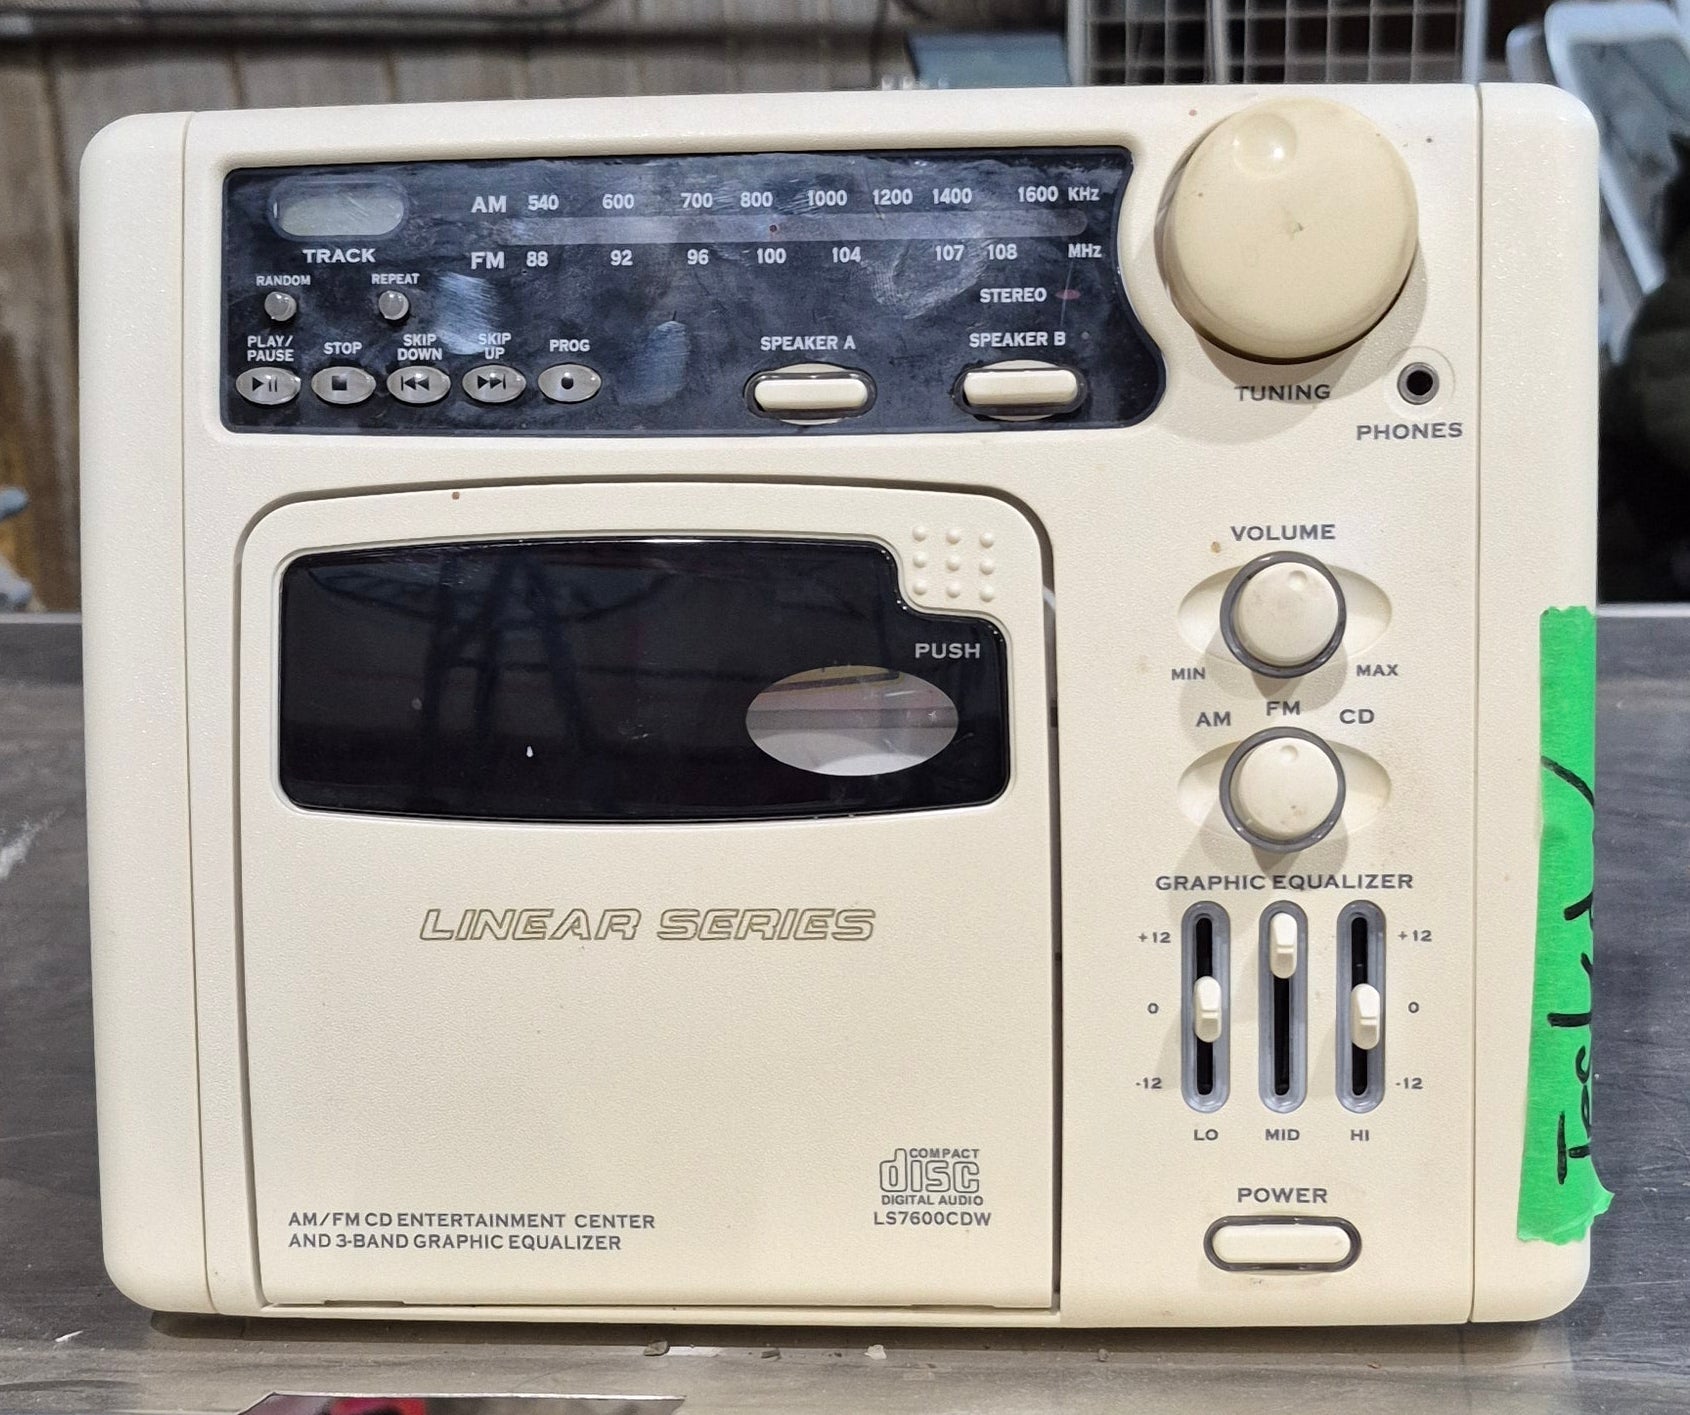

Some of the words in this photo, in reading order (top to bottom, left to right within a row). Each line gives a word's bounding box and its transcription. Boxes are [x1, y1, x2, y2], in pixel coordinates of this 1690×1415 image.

[471, 196, 507, 213] AM
[527, 194, 559, 211] 540
[602, 194, 634, 210] 600
[681, 192, 713, 209] 700
[740, 191, 773, 207] 800
[807, 190, 847, 206] 1000
[873, 189, 913, 205] 1200
[932, 187, 972, 204] 1400
[1018, 186, 1059, 202] 1600
[1068, 187, 1100, 201] KHz
[303, 248, 375, 263] TRACK
[471, 251, 505, 269] FM
[526, 251, 548, 267] 88
[611, 250, 633, 266] 92
[687, 249, 709, 265] 96
[756, 248, 786, 264] 100
[832, 247, 861, 263] 104
[935, 245, 964, 261] 107
[988, 244, 1017, 260] 108
[1068, 244, 1102, 258] MHz
[256, 275, 311, 286] RANDOM
[371, 273, 420, 285] REPEAT
[980, 287, 1047, 303] STEREO
[246, 335, 292, 349] PLAY/
[403, 334, 437, 347] SKIP
[478, 332, 512, 346] SKIP
[549, 339, 590, 353] PROG
[760, 336, 838, 352] SPEAKER
[842, 336, 855, 350] A
[969, 332, 1048, 348] SPEAKER
[1053, 331, 1066, 346] B
[246, 348, 294, 362] PAUSE
[323, 341, 362, 355] STOP
[397, 347, 442, 361] DOWN
[484, 346, 505, 360] UP
[1234, 384, 1331, 401] TUNING
[1356, 422, 1463, 440] PHONES
[1230, 524, 1336, 541] VOLUME
[915, 643, 981, 659] PUSH
[1171, 667, 1206, 681] MIN
[1356, 663, 1399, 677] MAX
[1266, 700, 1300, 716] FM
[1196, 711, 1231, 727] AM
[1339, 708, 1375, 725] CD
[1155, 875, 1266, 891] GRAPHIC
[1272, 874, 1414, 890] EQUALIZER
[419, 908, 641, 941] LINEAR
[656, 908, 876, 941] SERIES
[1138, 931, 1171, 944] +12
[1398, 930, 1433, 942] +12
[1147, 1003, 1159, 1014] 0
[1408, 1002, 1420, 1014] 0
[1136, 1077, 1162, 1090] -12
[1396, 1078, 1423, 1090] -12
[1194, 1128, 1219, 1141] LO
[1265, 1128, 1300, 1141] MID
[1350, 1129, 1370, 1141] HI
[910, 1148, 980, 1159] COMPACT
[882, 1195, 935, 1205] DIGITAL
[938, 1195, 983, 1206] AUDIO
[1237, 1188, 1328, 1204] POWER
[288, 1212, 360, 1227] AM/FM
[365, 1212, 392, 1227] CD
[398, 1213, 566, 1228] ENTERTAINMENT
[574, 1214, 655, 1229] CENTER
[874, 1211, 991, 1226] LS7600CDW
[288, 1234, 332, 1248] AND
[336, 1234, 409, 1249] 3-BAND
[413, 1235, 504, 1250] GRAPHIC
[509, 1235, 621, 1251] EQUALIZER
